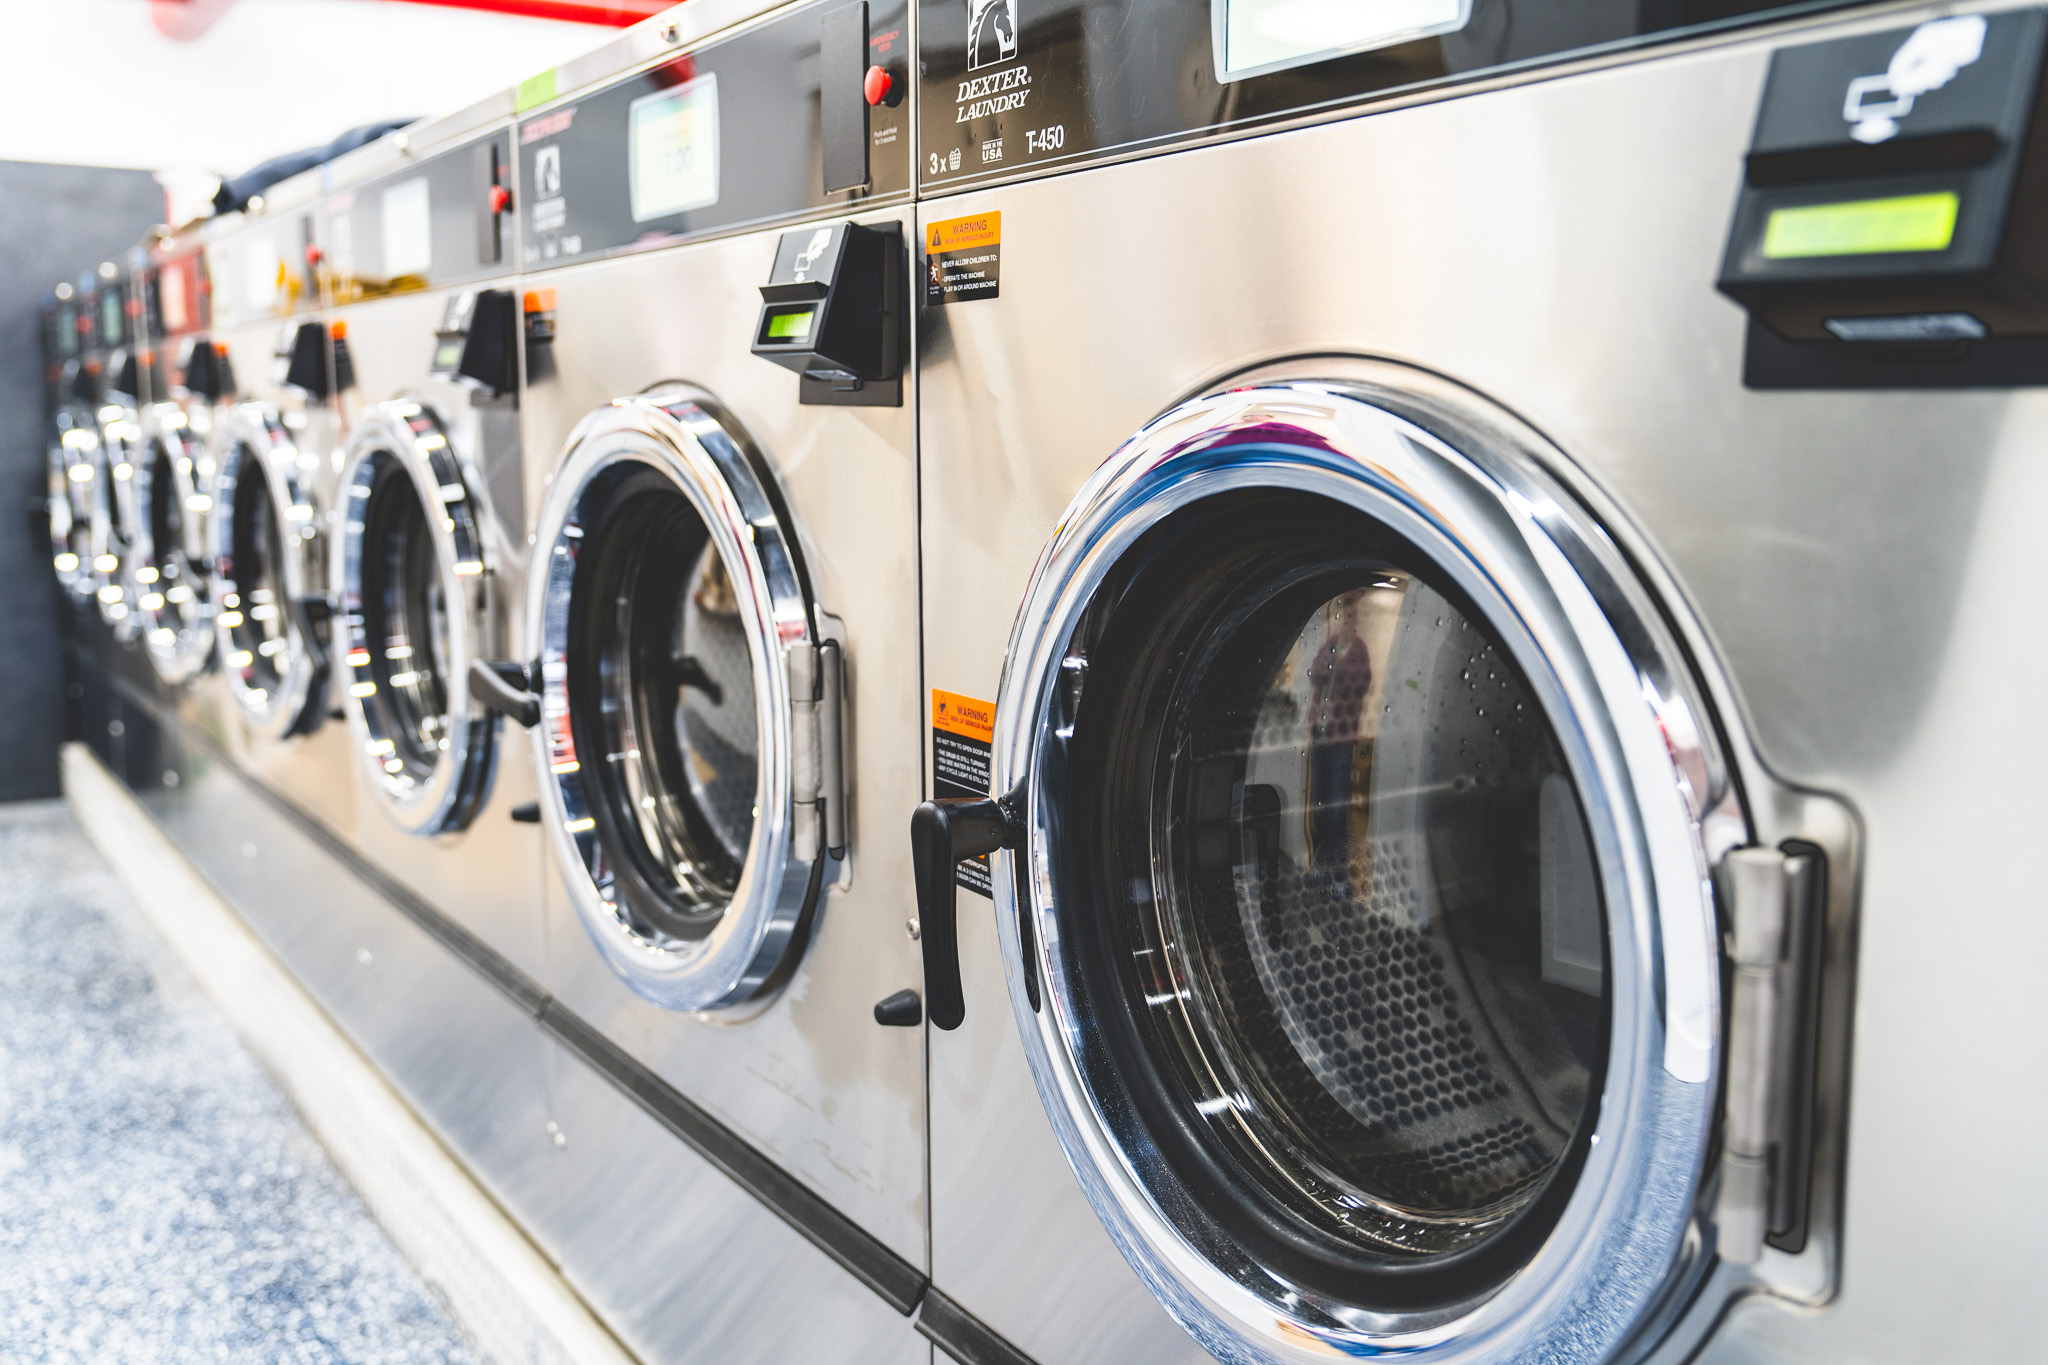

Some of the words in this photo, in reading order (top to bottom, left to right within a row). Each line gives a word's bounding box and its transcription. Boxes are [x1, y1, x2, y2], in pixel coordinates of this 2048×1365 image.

[956, 89, 1030, 124] LAUNDRY
[1025, 124, 1065, 154] T-450
[982, 147, 1003, 161] USA
[953, 220, 987, 234] WARNING
[979, 231, 994, 240] INJURY
[942, 261, 955, 269] NEVER
[954, 258, 969, 267] ALLOW
[969, 255, 990, 265] CHILDREN
[968, 270, 986, 279] MACHINE
[963, 282, 979, 290] AROUND
[979, 280, 997, 289] MACHINE
[956, 705, 988, 723] WARNING
